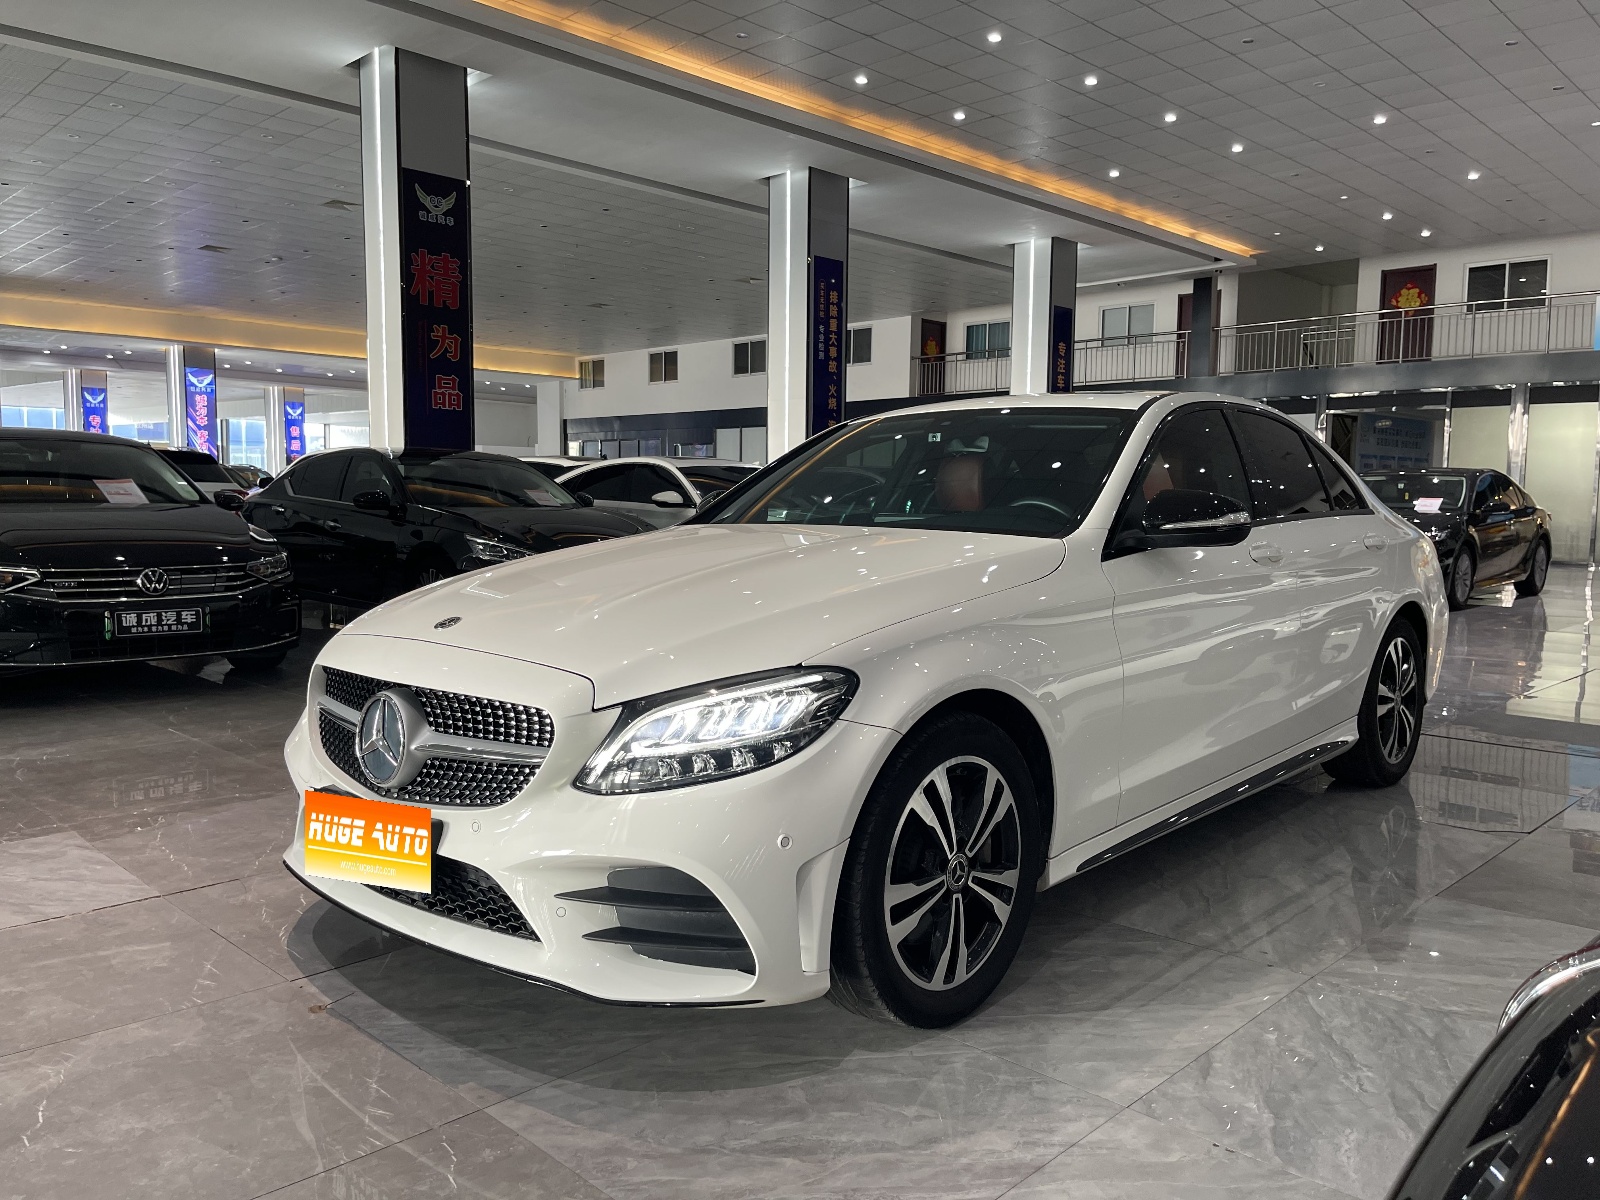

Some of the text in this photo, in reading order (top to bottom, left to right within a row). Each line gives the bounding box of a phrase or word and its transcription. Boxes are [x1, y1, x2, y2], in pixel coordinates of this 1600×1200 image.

[410, 248, 463, 410] 精为品
[121, 610, 197, 627] 诚成汽车
